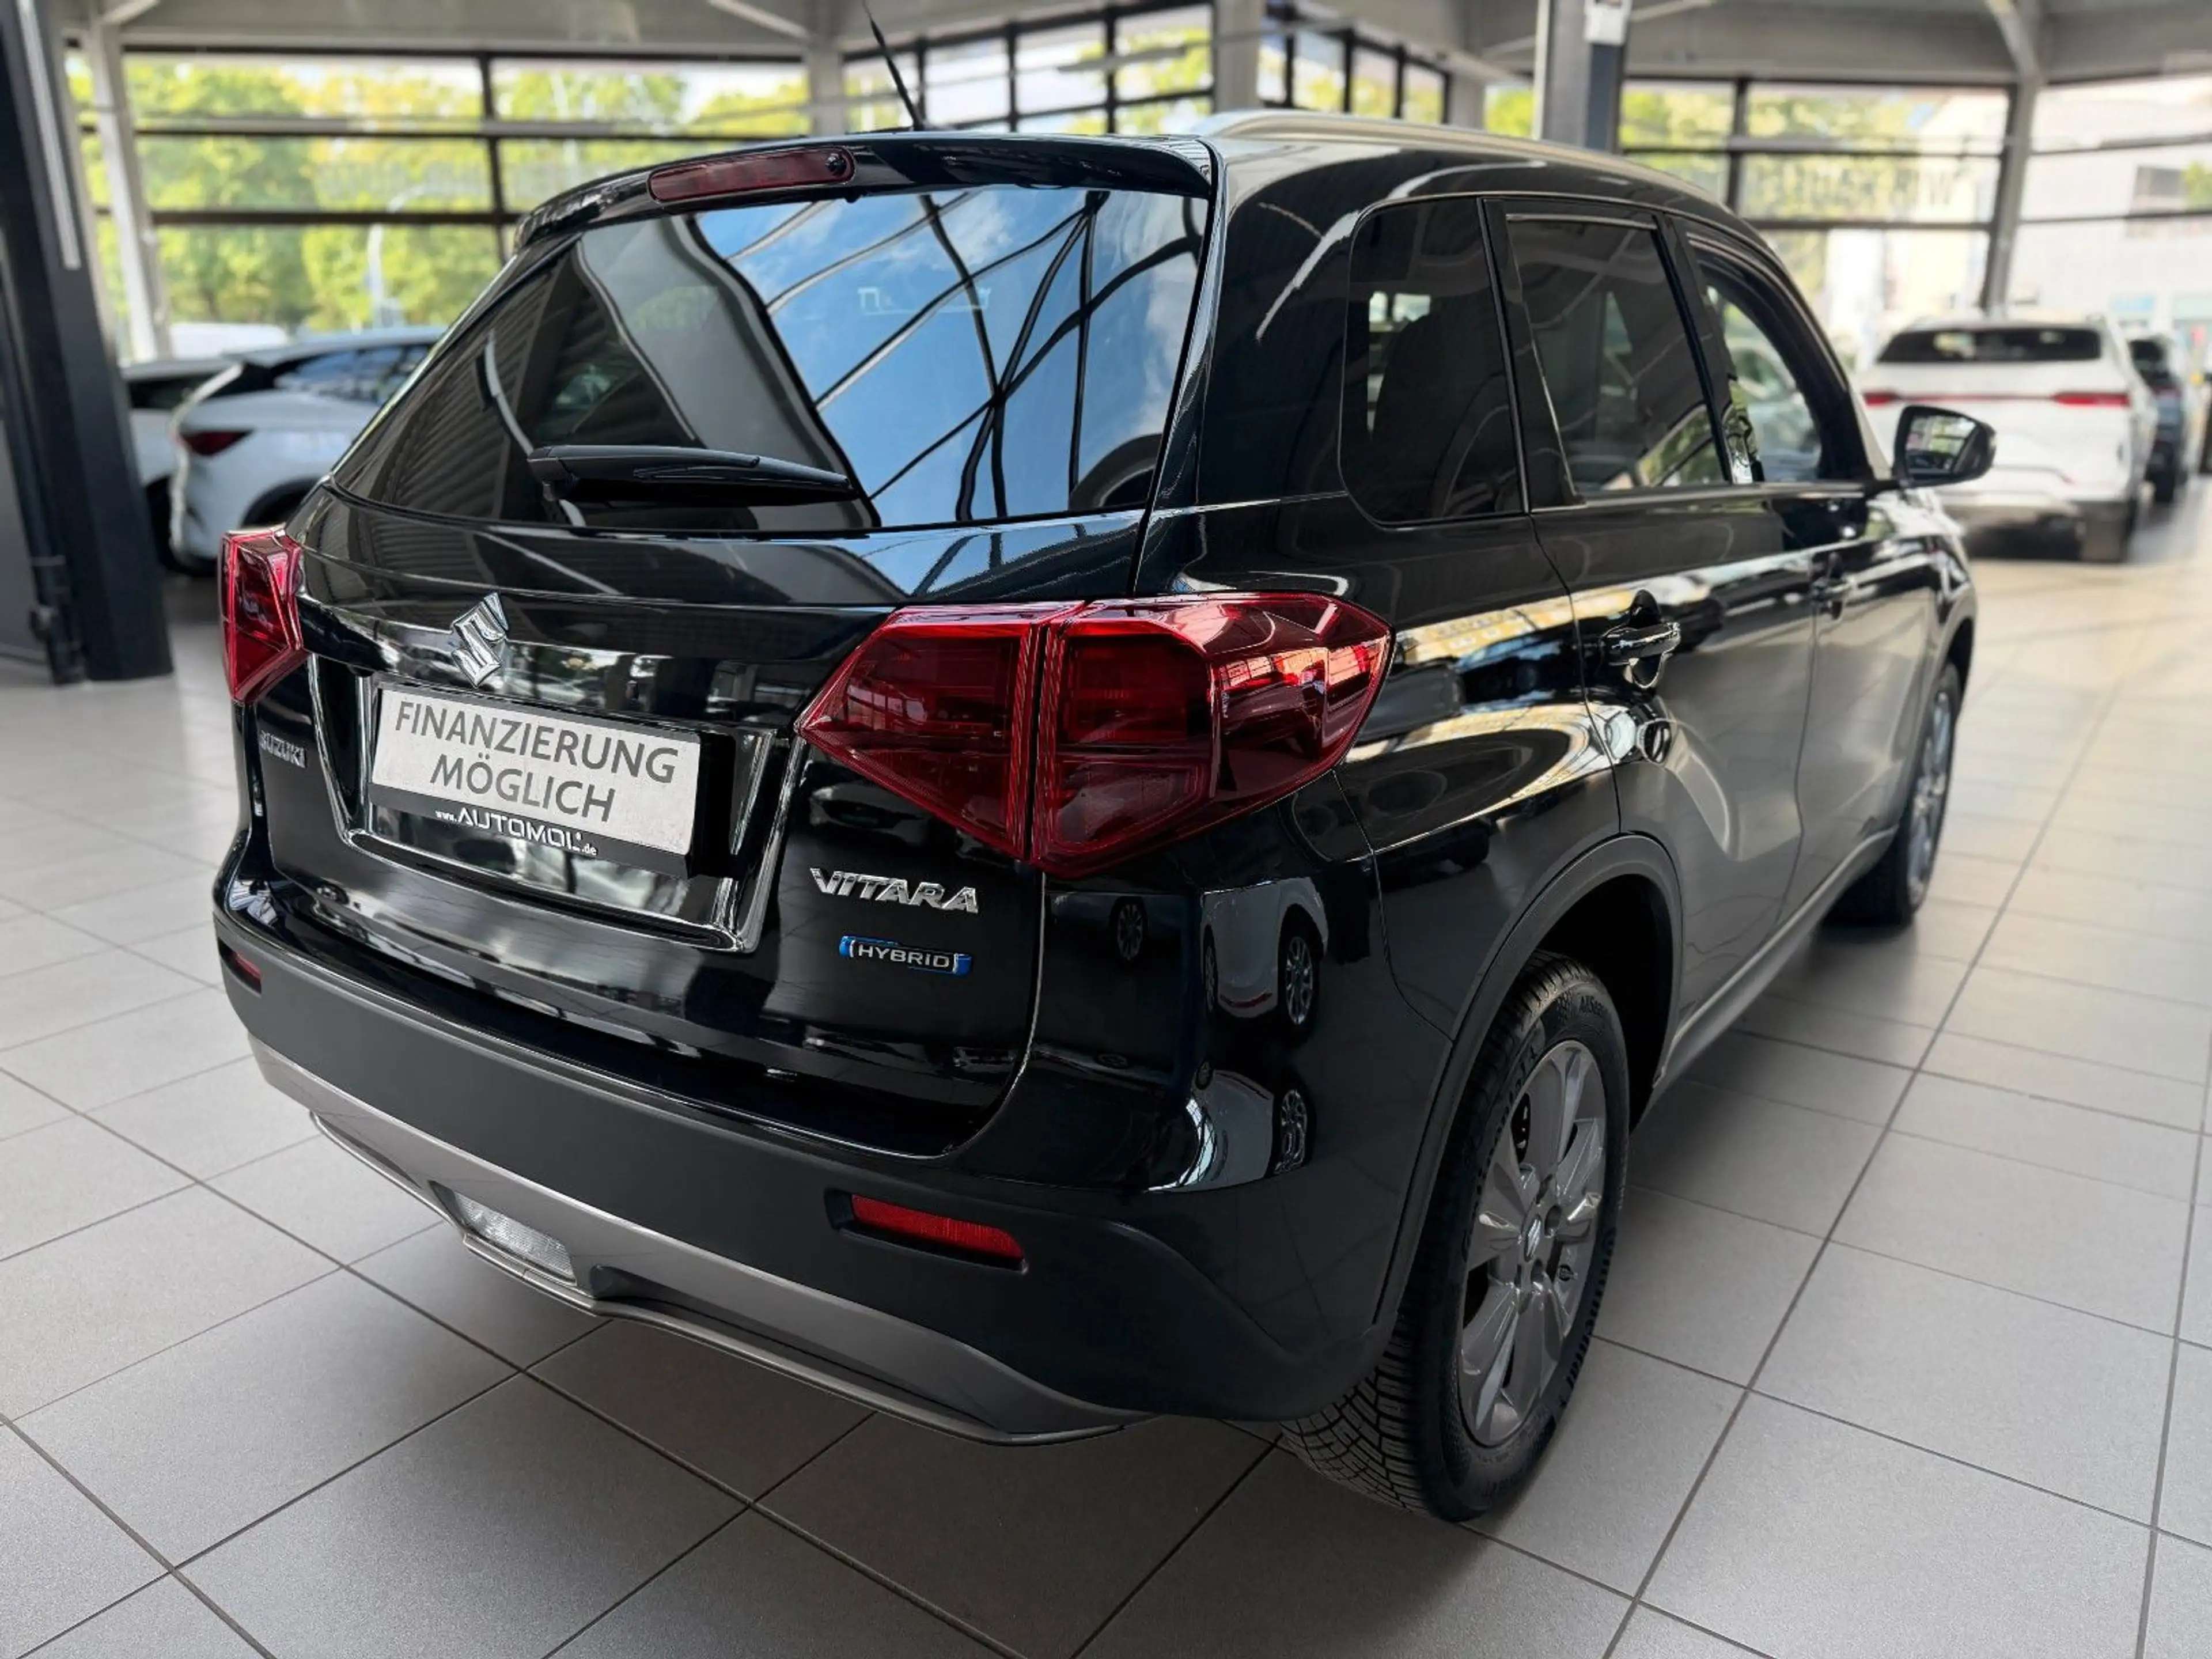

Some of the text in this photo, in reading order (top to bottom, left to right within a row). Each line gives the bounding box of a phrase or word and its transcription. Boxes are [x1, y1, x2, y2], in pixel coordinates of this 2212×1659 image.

[259, 730, 305, 769] SUZUKI
[395, 700, 679, 784] FINANZIERUNG
[430, 752, 616, 823] MÖGLICH
[810, 868, 979, 914] VITARA
[858, 944, 950, 968] HYBRID
